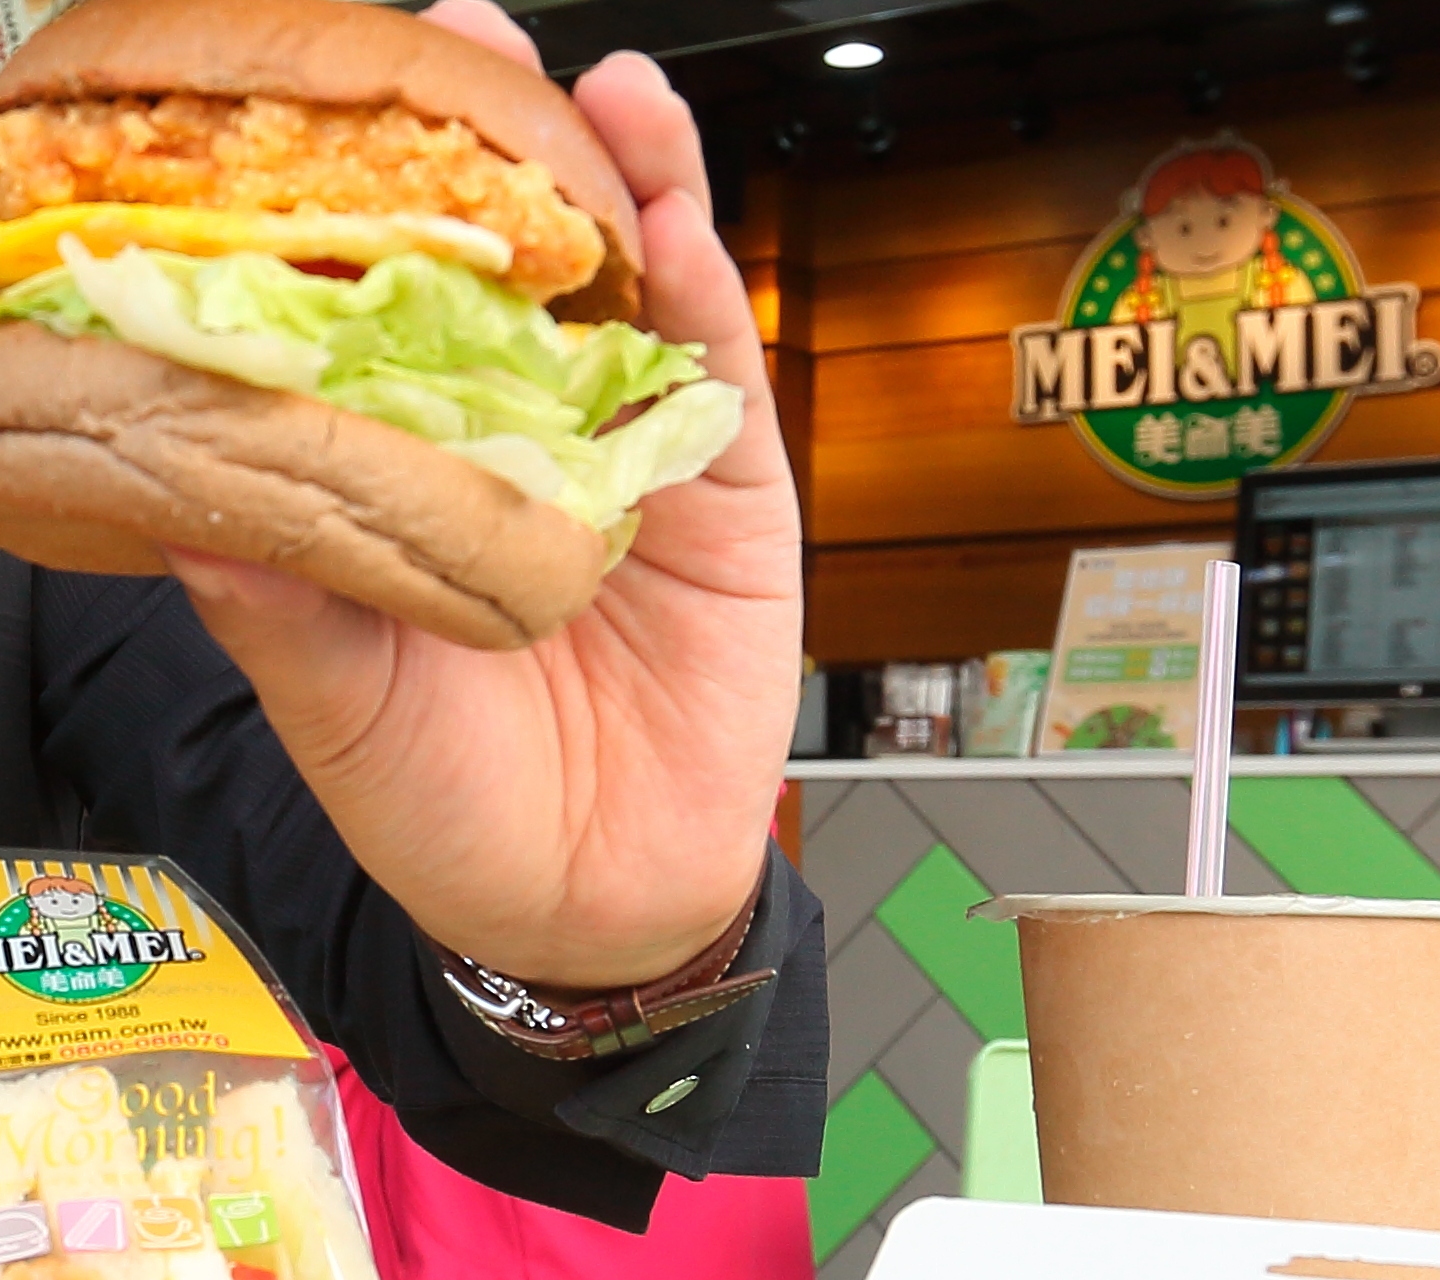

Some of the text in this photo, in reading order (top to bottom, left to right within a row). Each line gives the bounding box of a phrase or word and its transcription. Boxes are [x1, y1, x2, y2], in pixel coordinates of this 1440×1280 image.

[1019, 297, 1410, 414] MEI&MEI
[36, 1004, 141, 1027] Since 1988
[56, 1066, 217, 1124] Good
